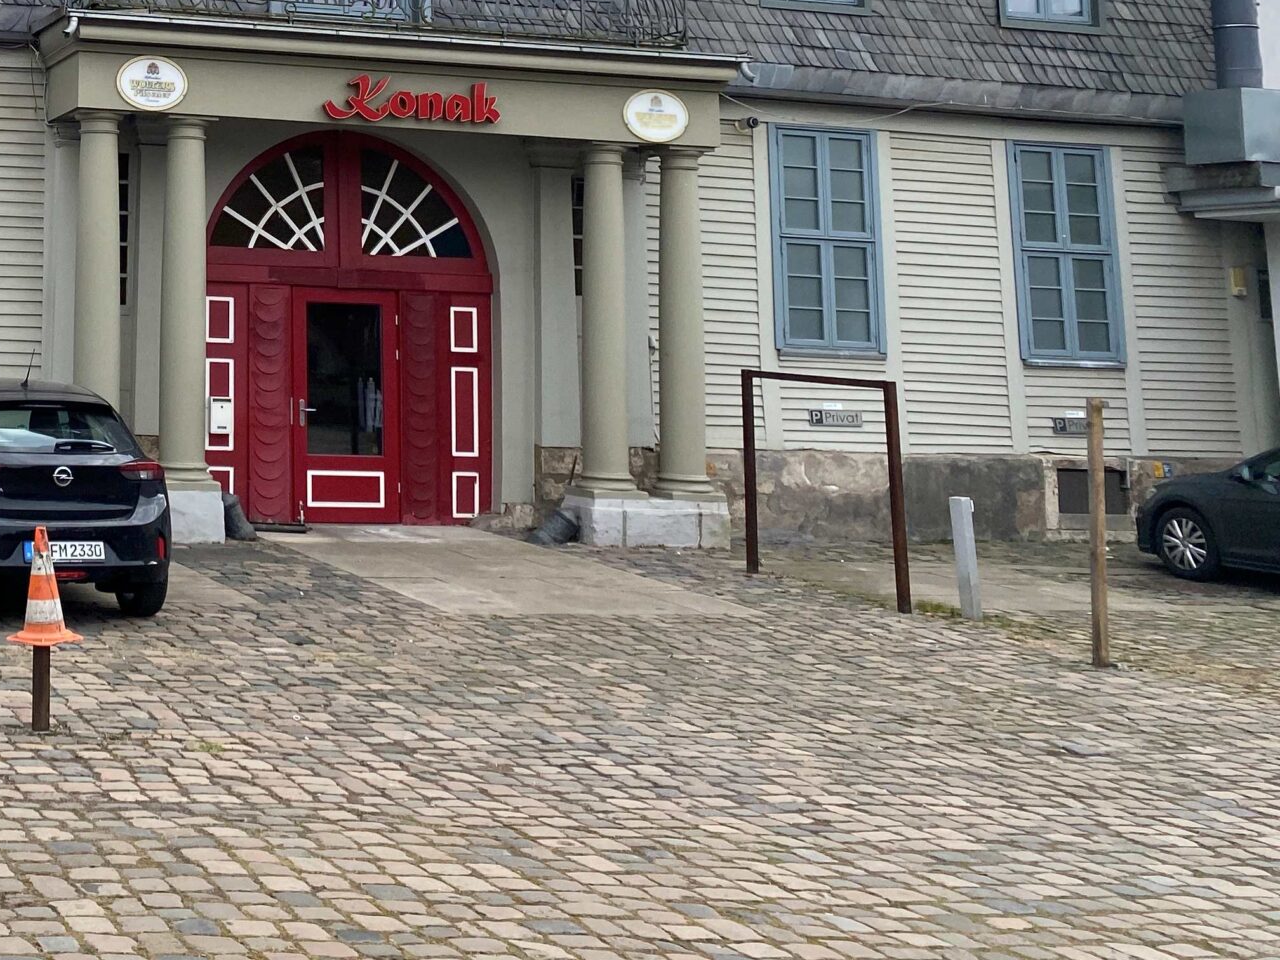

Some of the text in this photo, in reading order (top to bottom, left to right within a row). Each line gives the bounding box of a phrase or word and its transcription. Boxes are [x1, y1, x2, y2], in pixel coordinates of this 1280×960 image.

[323, 73, 501, 124] Konak
[824, 412, 859, 424] Privat
[1068, 419, 1089, 431] Priv
[51, 544, 102, 557] FM 2330
